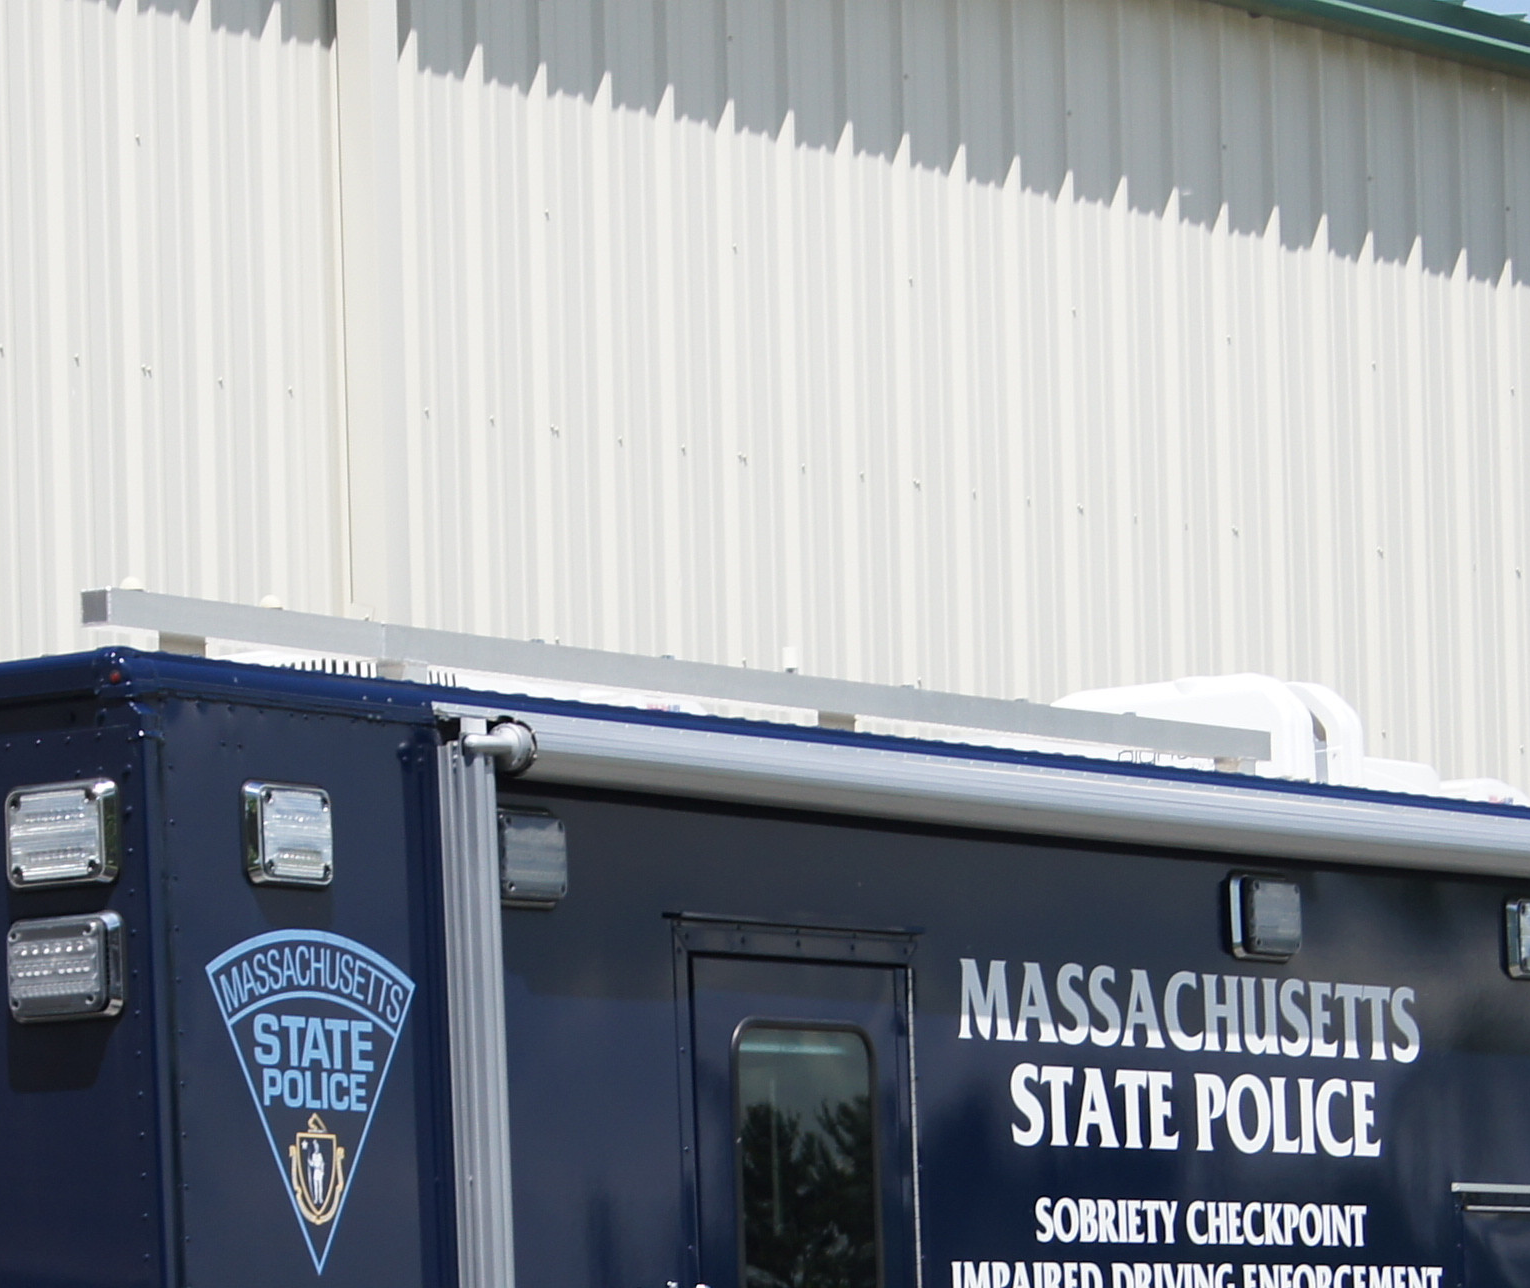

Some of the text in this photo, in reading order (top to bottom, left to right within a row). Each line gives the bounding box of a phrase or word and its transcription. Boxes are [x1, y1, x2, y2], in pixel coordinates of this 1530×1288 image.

[220, 945, 403, 1023] MASSACHUSETTS
[957, 958, 1420, 1064] MASSACHUSETTS
[253, 1013, 375, 1072] STATE
[262, 1067, 368, 1112] POLICE
[1010, 1062, 1383, 1158] STATE POLICE
[1034, 1197, 1368, 1248] SOBRIETY CHECKPOINT
